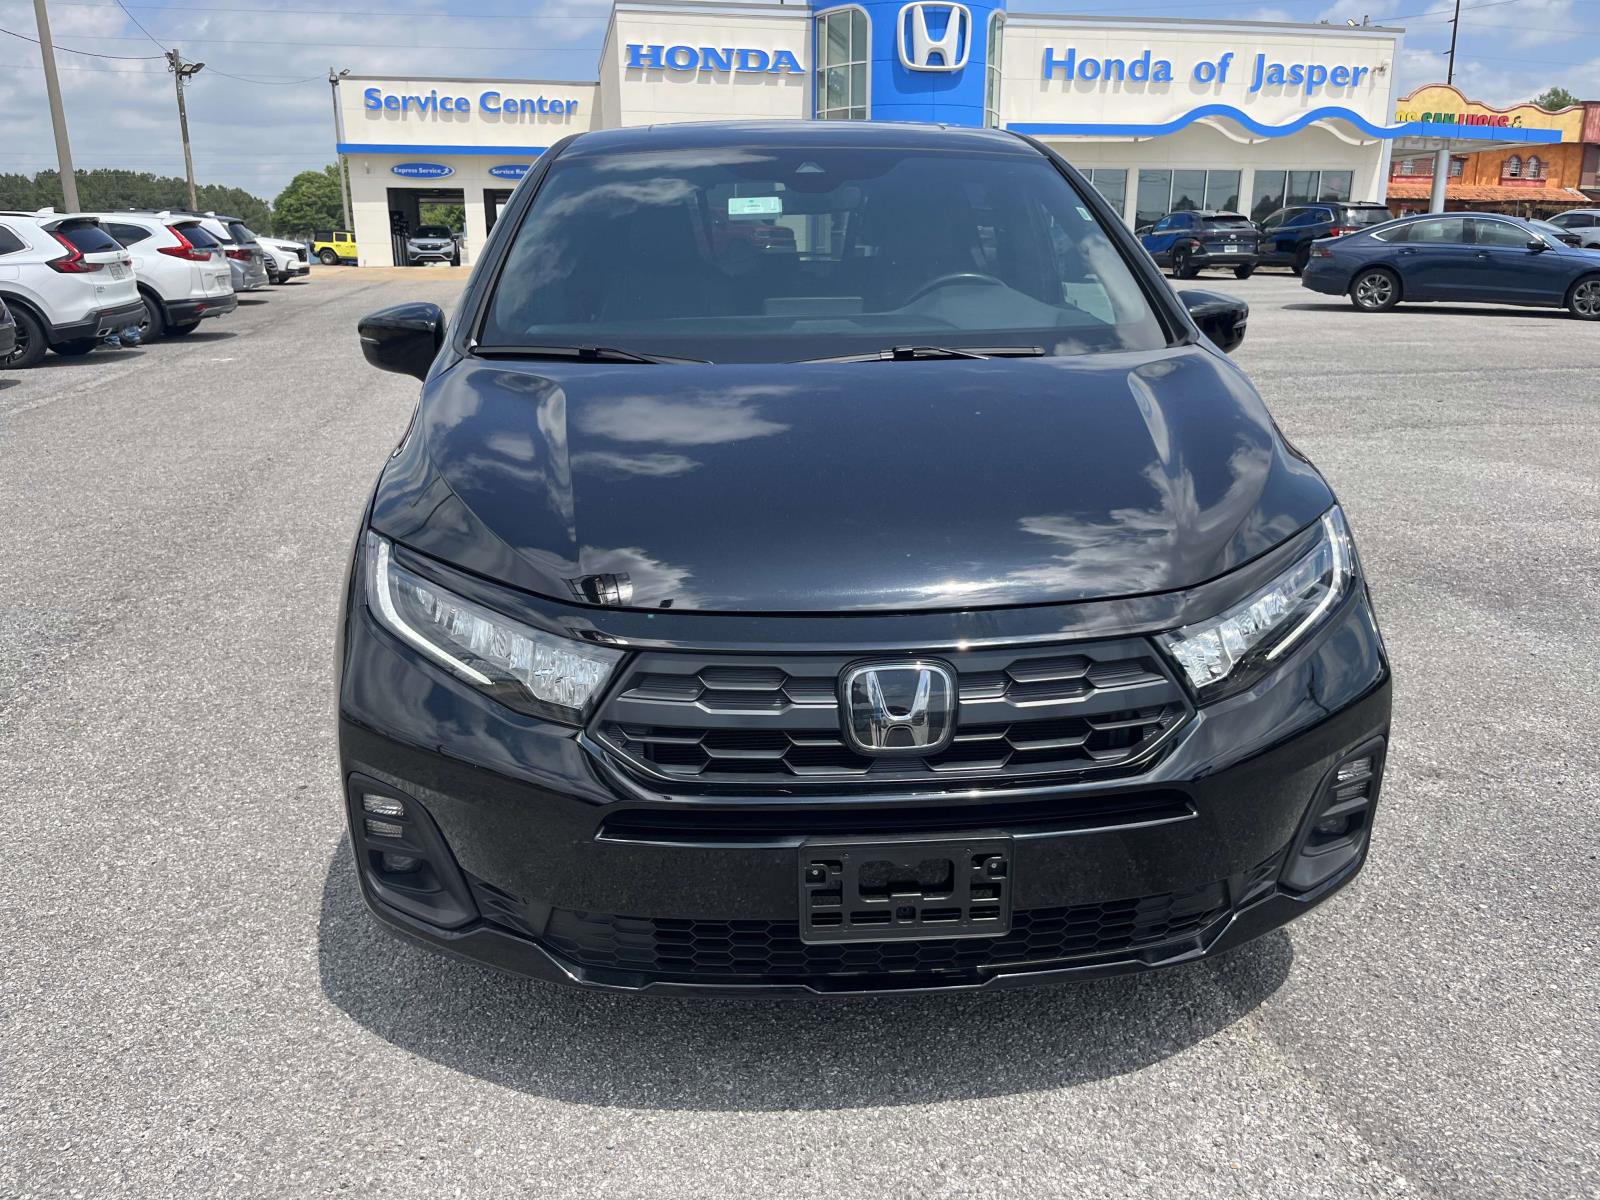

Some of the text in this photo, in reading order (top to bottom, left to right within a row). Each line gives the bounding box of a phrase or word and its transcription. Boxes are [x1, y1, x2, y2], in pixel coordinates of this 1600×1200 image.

[625, 43, 806, 74] HONDA
[1043, 47, 1369, 96] Honda of Jasper
[364, 87, 579, 115] Service Center
[393, 166, 418, 175] Express
